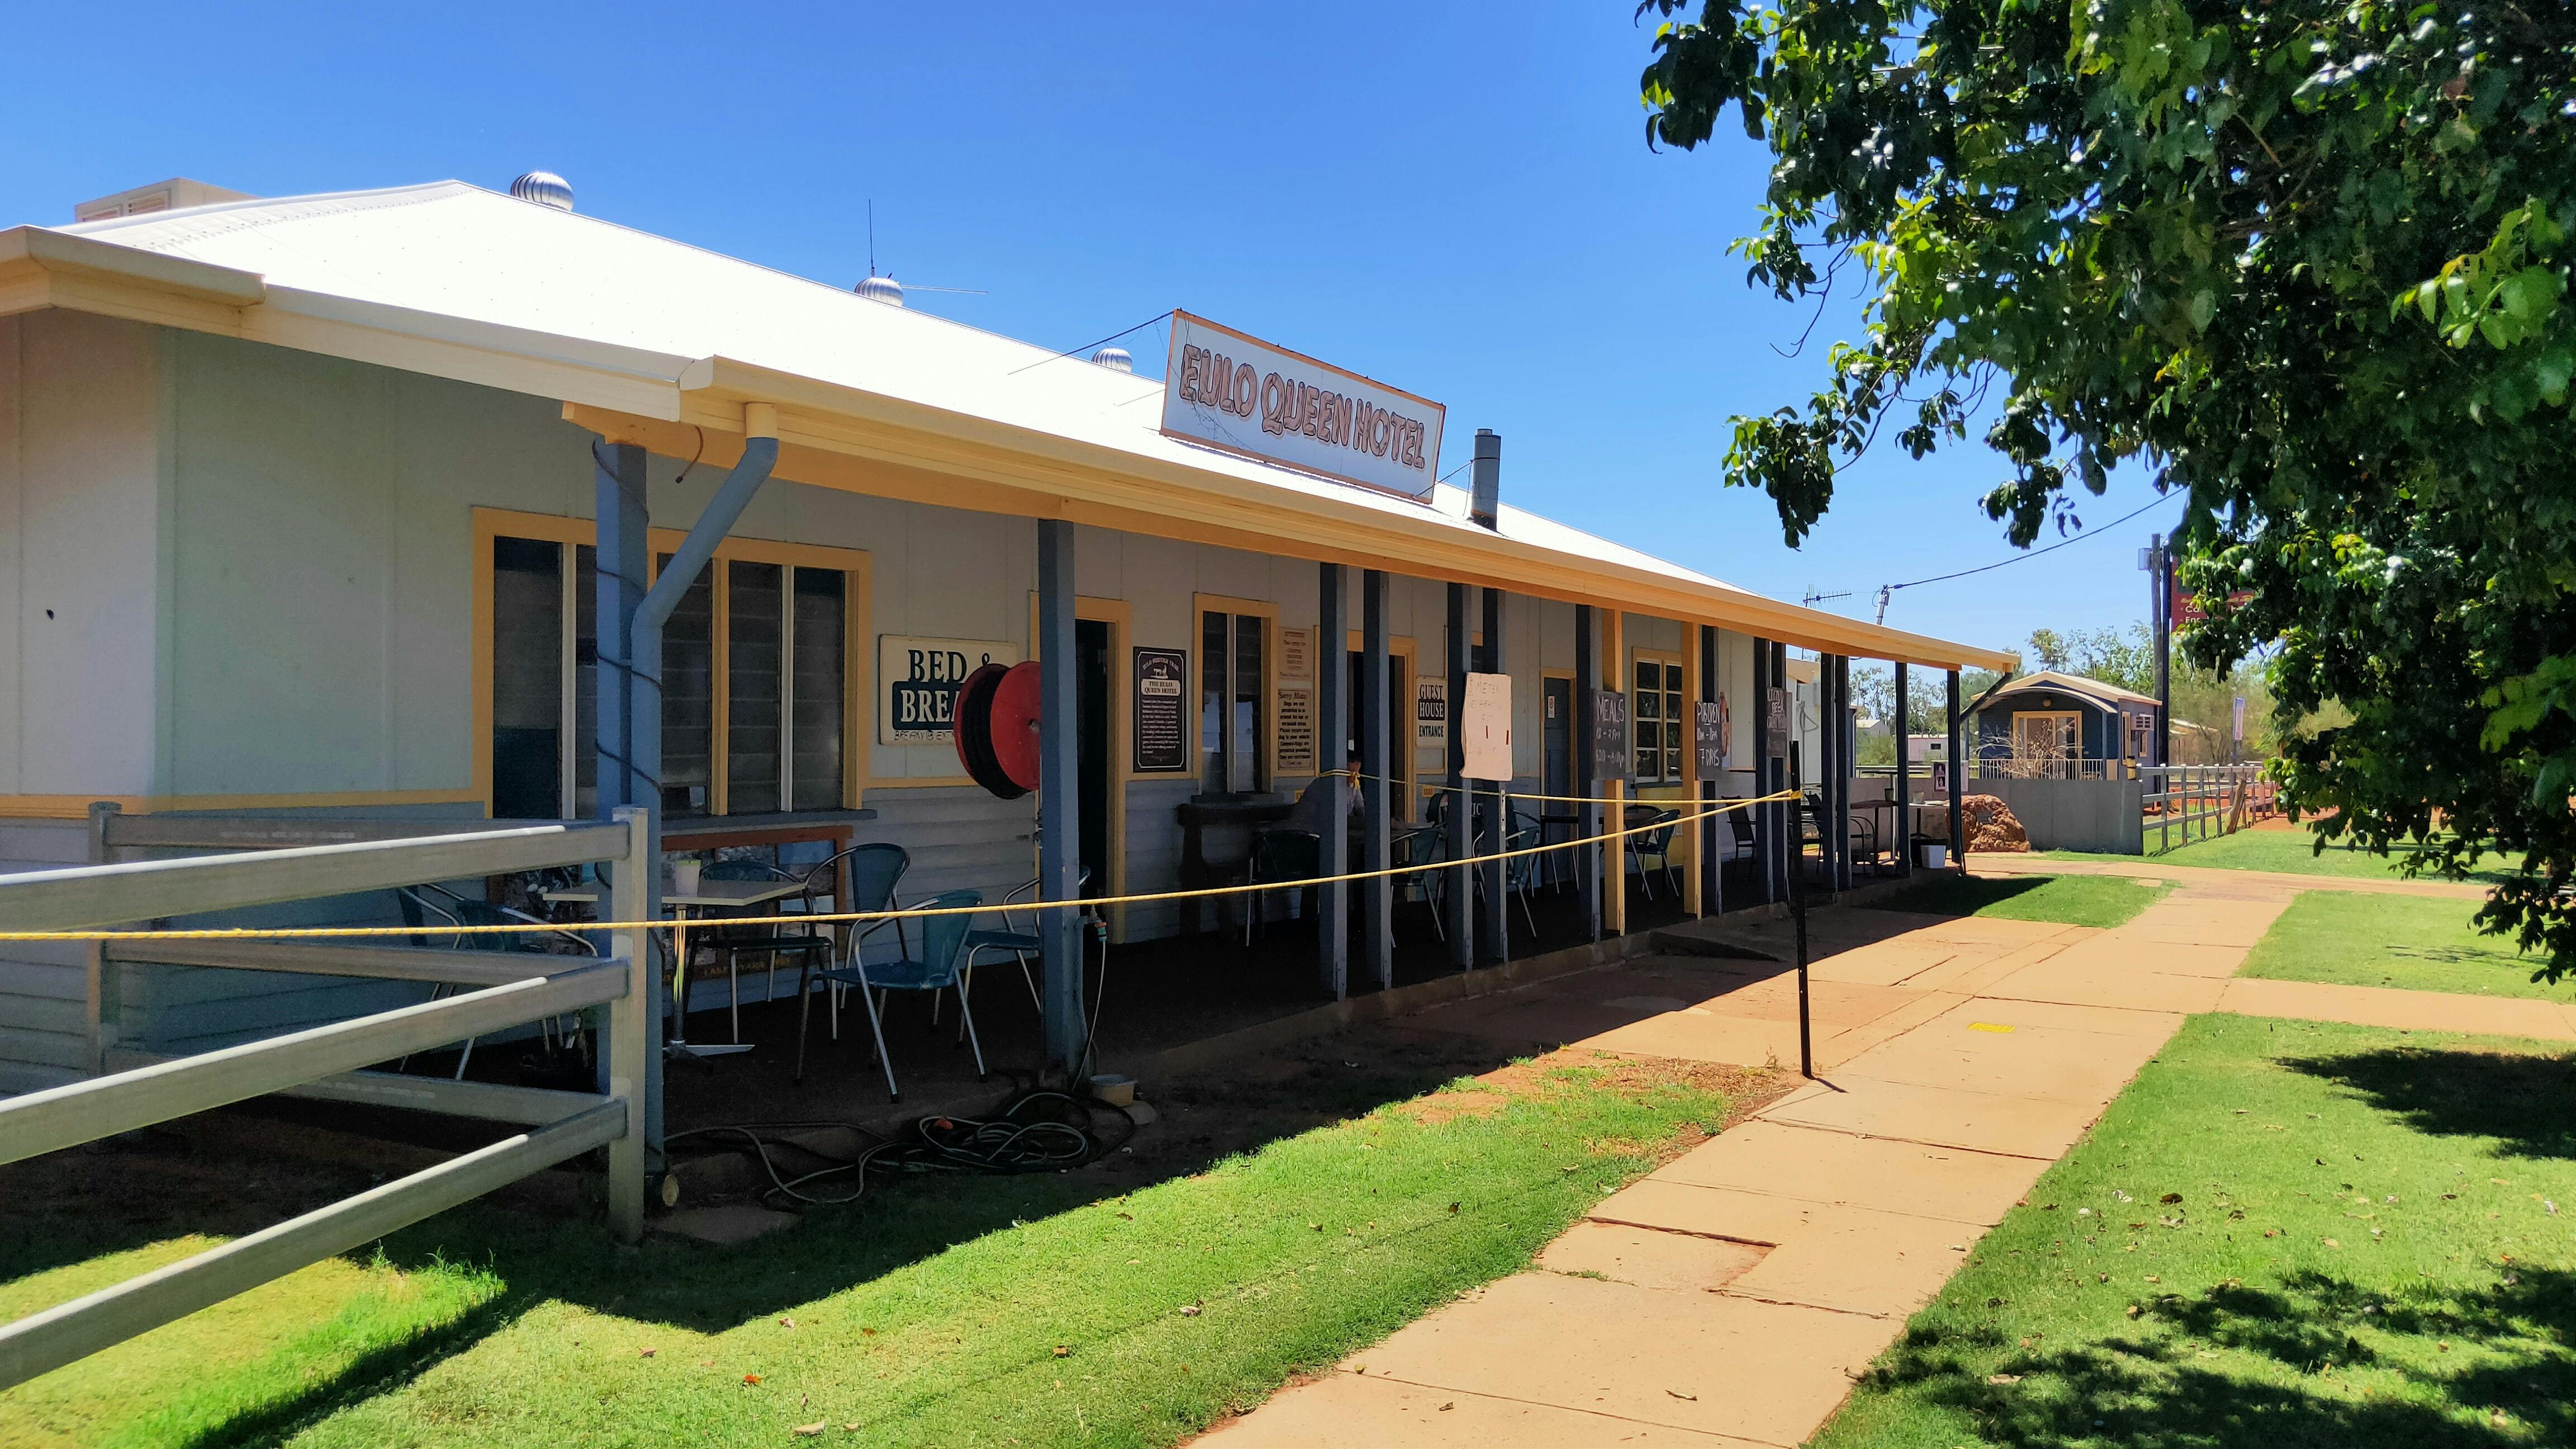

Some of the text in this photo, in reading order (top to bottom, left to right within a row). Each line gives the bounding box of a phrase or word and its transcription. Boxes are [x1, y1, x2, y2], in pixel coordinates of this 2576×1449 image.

[1180, 344, 1425, 468] EULO QUEEN HOTEL
[908, 649, 967, 683] BED
[1419, 684, 1443, 699] GUEST
[900, 690, 960, 722] BRE
[1419, 702, 1444, 717] HOUSE
[1597, 695, 1625, 723] MEALS
[1697, 702, 1707, 723] PUB
[936, 731, 954, 740] EXT
[1419, 725, 1444, 737] ENTRANCE
[1699, 748, 1720, 767] 7 DAYS
